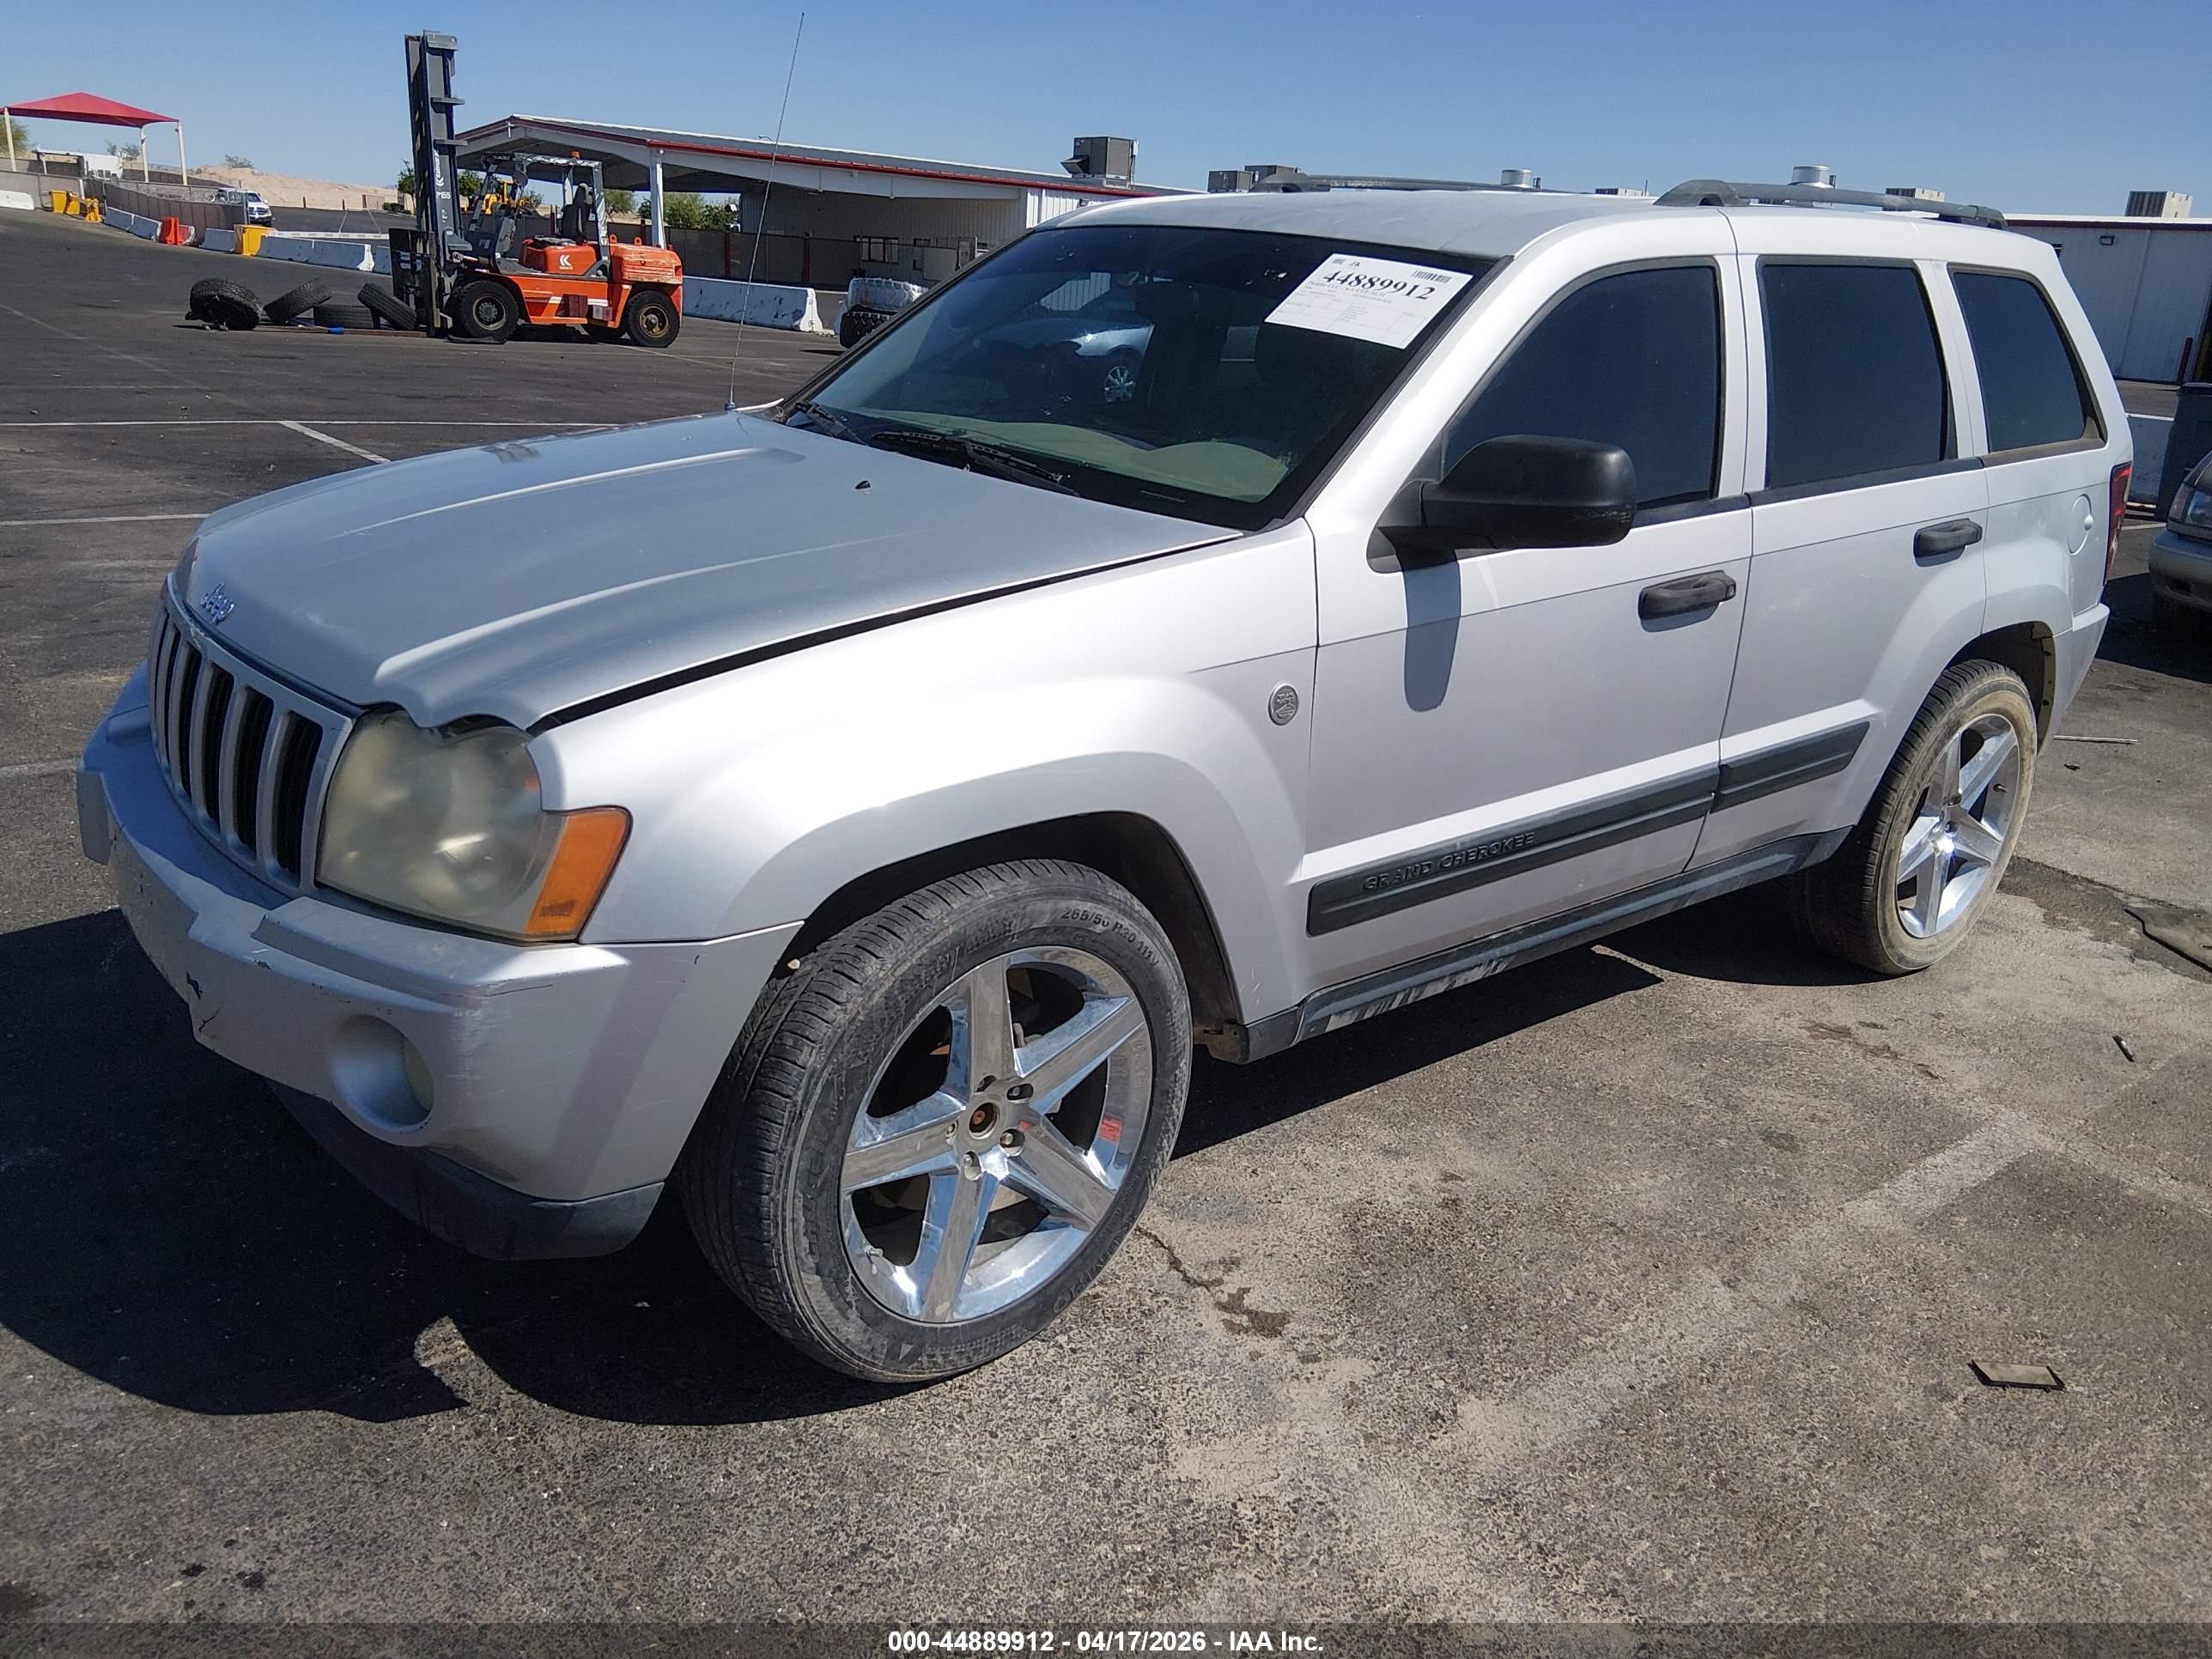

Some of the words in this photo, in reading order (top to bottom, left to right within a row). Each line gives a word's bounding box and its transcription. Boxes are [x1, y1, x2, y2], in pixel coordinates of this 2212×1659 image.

[1323, 270, 1435, 300] 44889912
[199, 582, 234, 624] Jeep
[1363, 860, 1433, 890] GRAND
[1439, 832, 1534, 869] CHEROKEE
